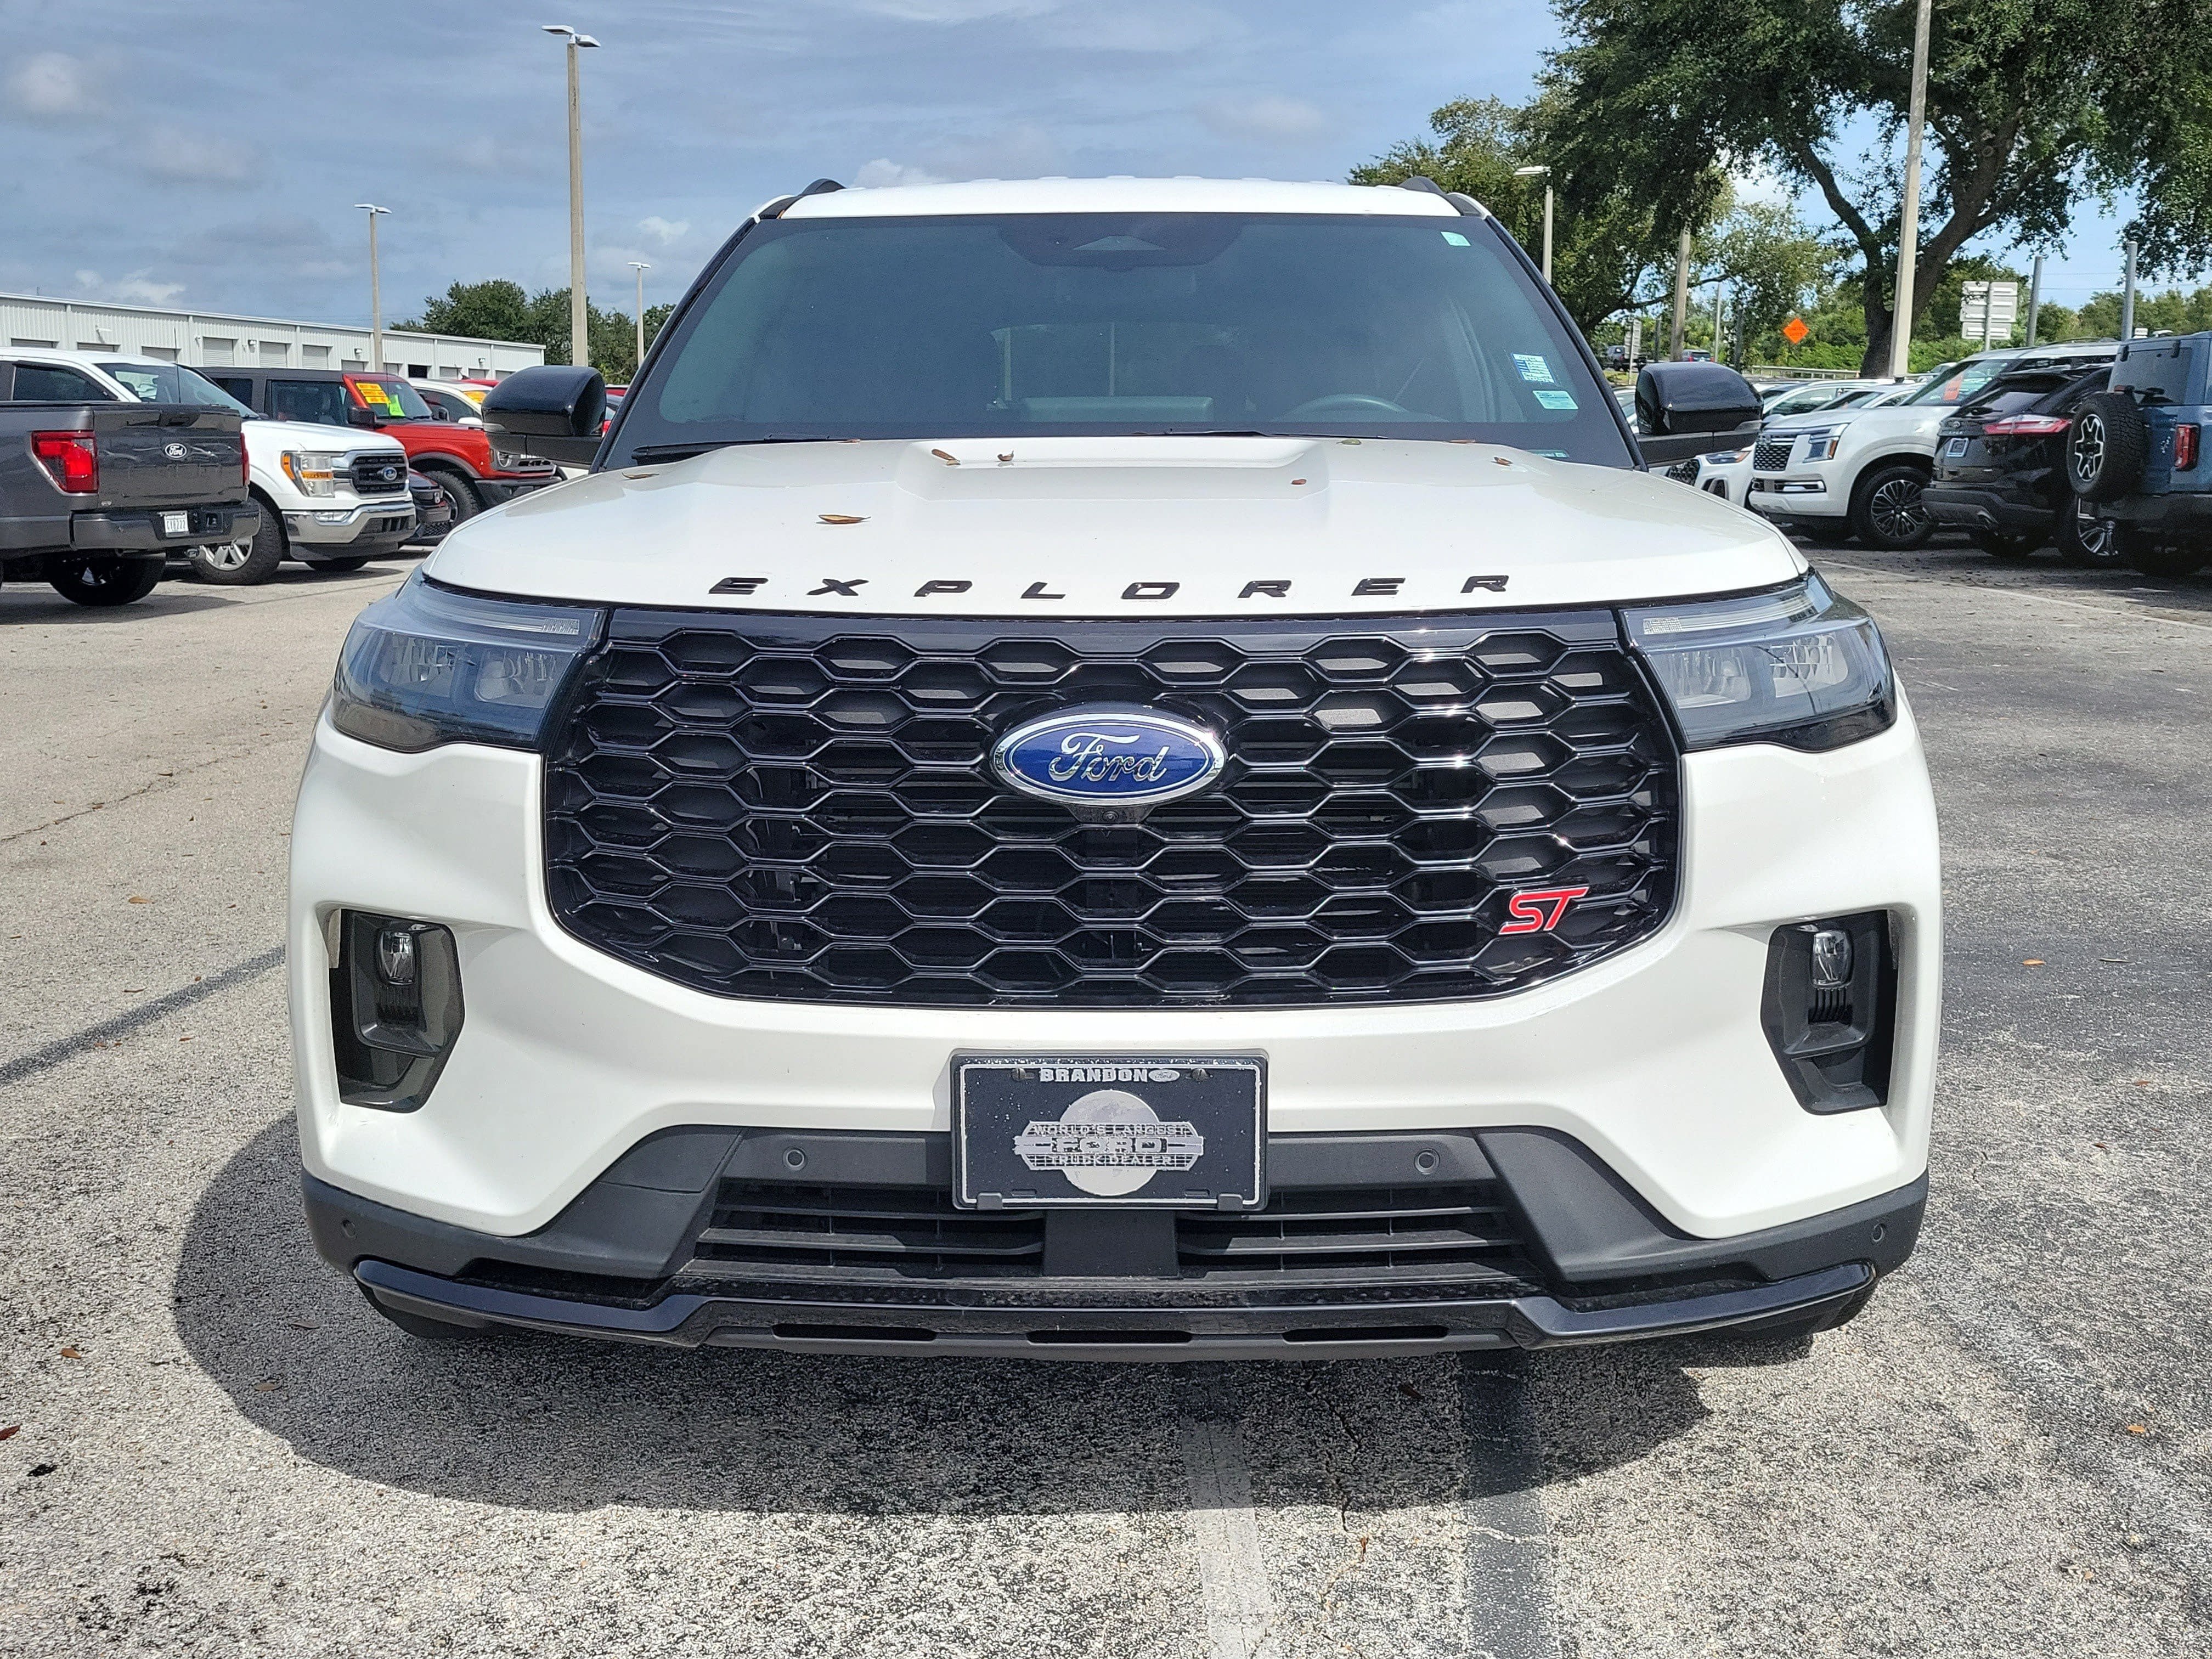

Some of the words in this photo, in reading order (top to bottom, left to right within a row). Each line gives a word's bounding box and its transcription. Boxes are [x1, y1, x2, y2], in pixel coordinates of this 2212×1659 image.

[169, 445, 183, 455] Ford
[708, 574, 1509, 600] EXPLORER
[1048, 732, 1170, 782] Ford
[1498, 886, 1589, 935] ST
[1040, 1068, 1148, 1082] BRANDON
[1033, 1125, 1106, 1136] WORLD'S
[1112, 1125, 1188, 1136] LARGEST
[1056, 1137, 1162, 1153] FORD
[1049, 1155, 1105, 1165] TRUCK
[1114, 1155, 1172, 1165] DEALER
